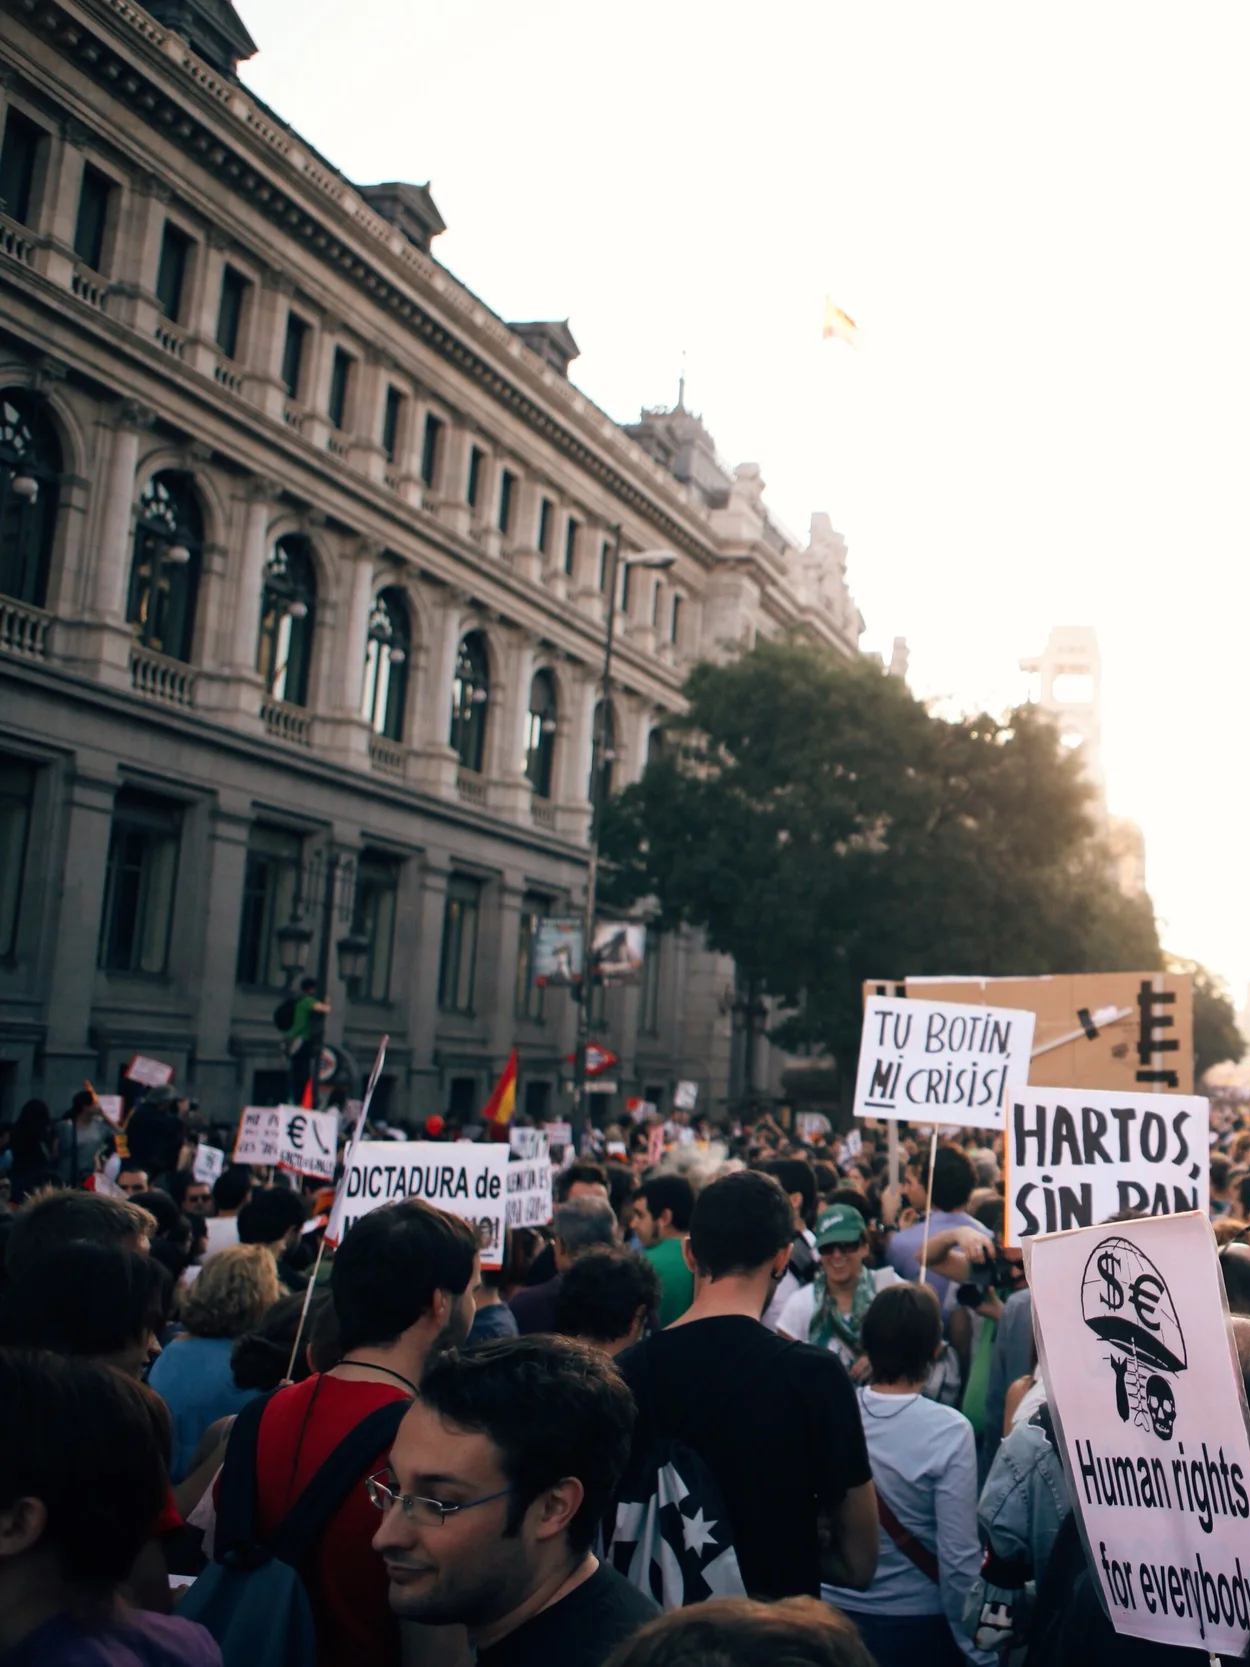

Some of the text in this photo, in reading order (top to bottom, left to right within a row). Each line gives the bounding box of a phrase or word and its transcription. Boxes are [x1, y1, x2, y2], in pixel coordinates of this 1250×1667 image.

[875, 1010, 912, 1050] TU
[1014, 1103, 1200, 1180] HARTOS,
[347, 1166, 470, 1199] DICTADURA
[475, 1167, 500, 1199] de
[1075, 1439, 1249, 1533] Human rights
[1100, 1541, 1137, 1610] for
